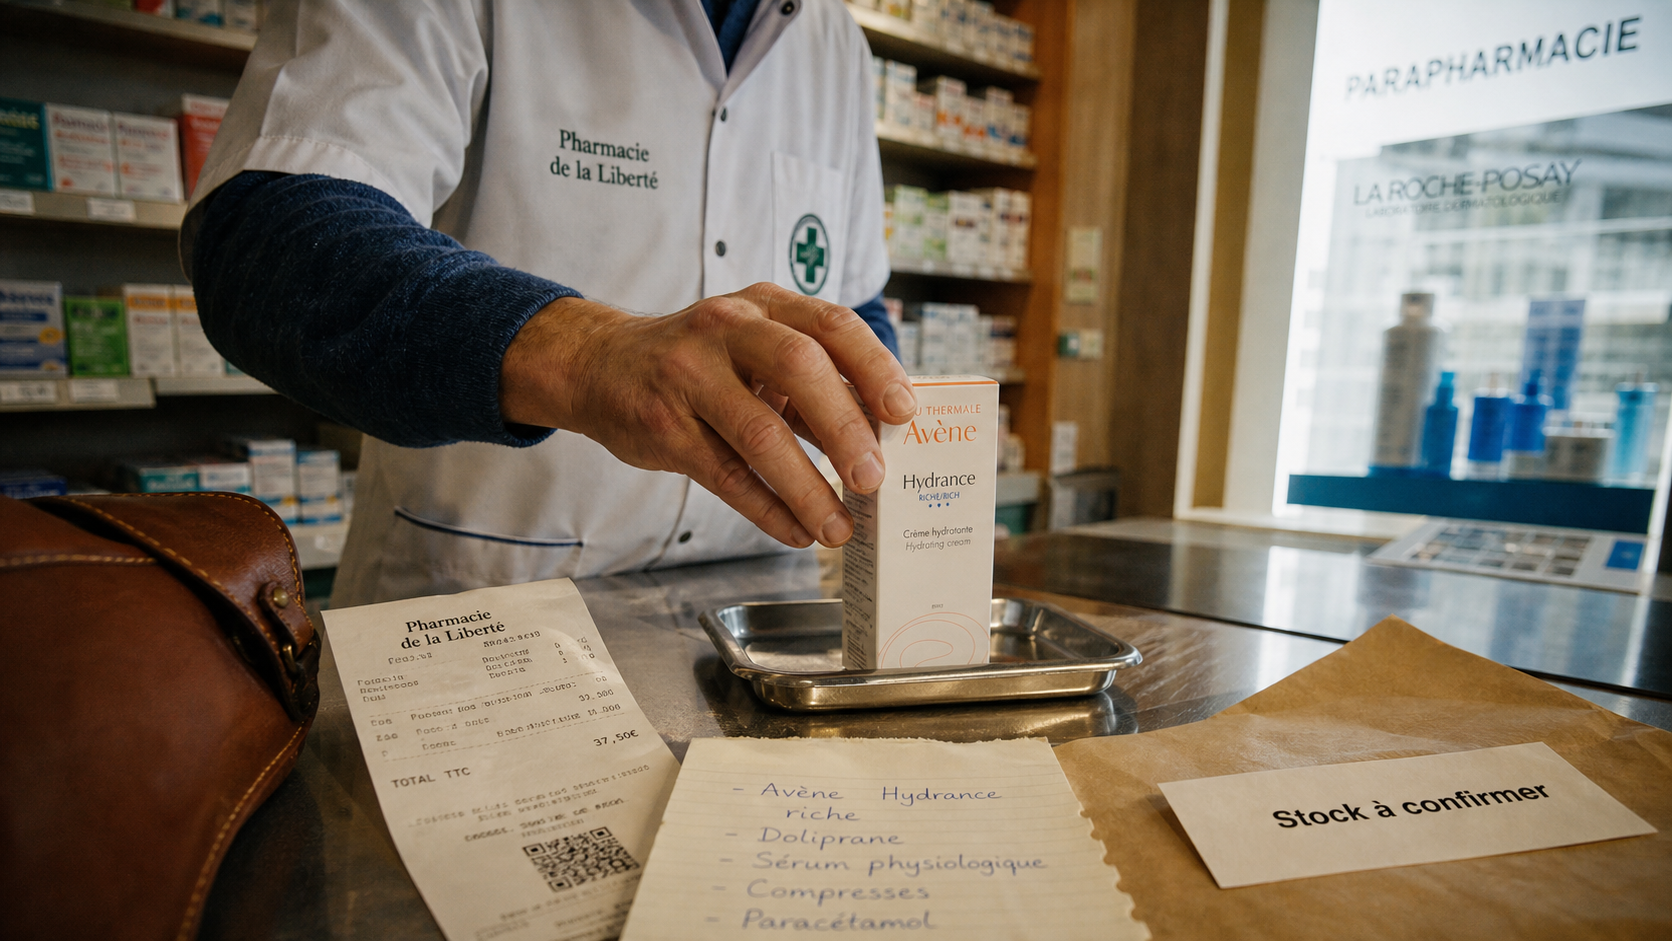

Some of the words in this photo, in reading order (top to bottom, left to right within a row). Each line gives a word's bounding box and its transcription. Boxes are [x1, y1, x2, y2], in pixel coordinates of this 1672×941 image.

[1346, 16, 1642, 97] PARAPHARMACIE
[559, 129, 650, 162] Pharmacie
[550, 156, 571, 178] de
[576, 160, 591, 181] la
[597, 163, 659, 190] Liberté
[1354, 183, 1383, 206] LA
[1389, 157, 1583, 202] ROCHE-POSAY
[926, 403, 981, 416] THERMALE
[903, 419, 977, 445] Avène
[903, 471, 976, 494] Hydrance
[902, 529, 930, 539] Crème
[905, 540, 945, 553] Hydrating
[946, 538, 971, 548] cream
[405, 610, 492, 633] Pharmacie
[401, 637, 421, 649] de
[424, 634, 441, 645] la
[445, 621, 506, 642] Liberté
[391, 772, 436, 789] TOTAL
[443, 766, 471, 780] TTC
[760, 782, 844, 800] Avène
[881, 786, 1002, 807] Hydrance
[1272, 803, 1370, 829] Stock
[1372, 800, 1397, 818] à
[1401, 784, 1550, 815] confirmer
[786, 806, 861, 821] riche
[756, 826, 905, 851] Doliprane
[751, 851, 850, 871] Sérum
[867, 853, 1049, 878] physiologique
[746, 877, 931, 908] Compresses
[740, 907, 939, 933] Paracétamol
